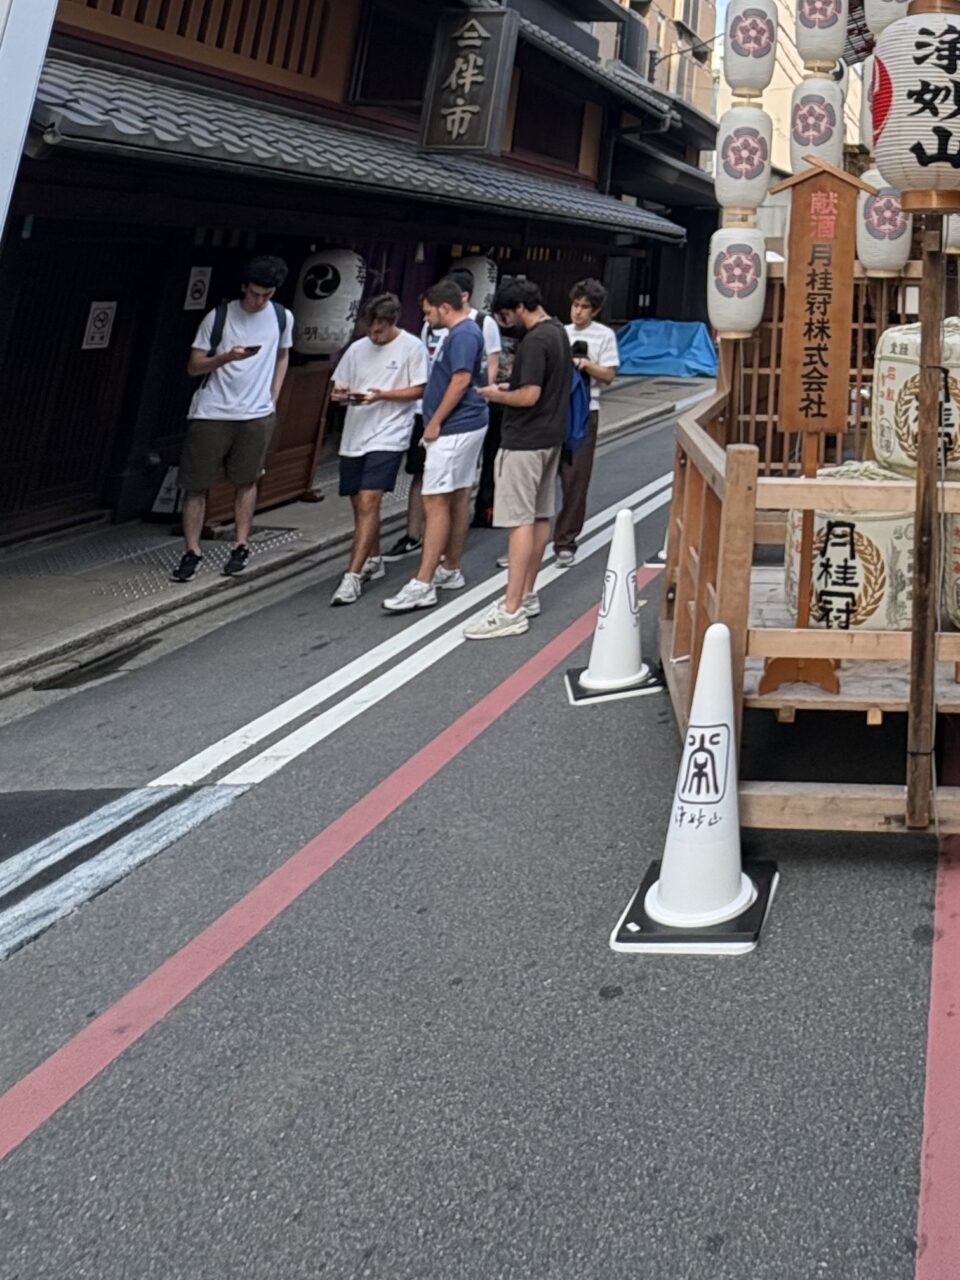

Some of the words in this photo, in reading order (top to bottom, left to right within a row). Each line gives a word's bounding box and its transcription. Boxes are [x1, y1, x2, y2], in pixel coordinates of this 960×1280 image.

[809, 191, 839, 239] 献酒
[799, 242, 833, 419] 月桂冠株式会社
[817, 520, 859, 629] 月桂冠
